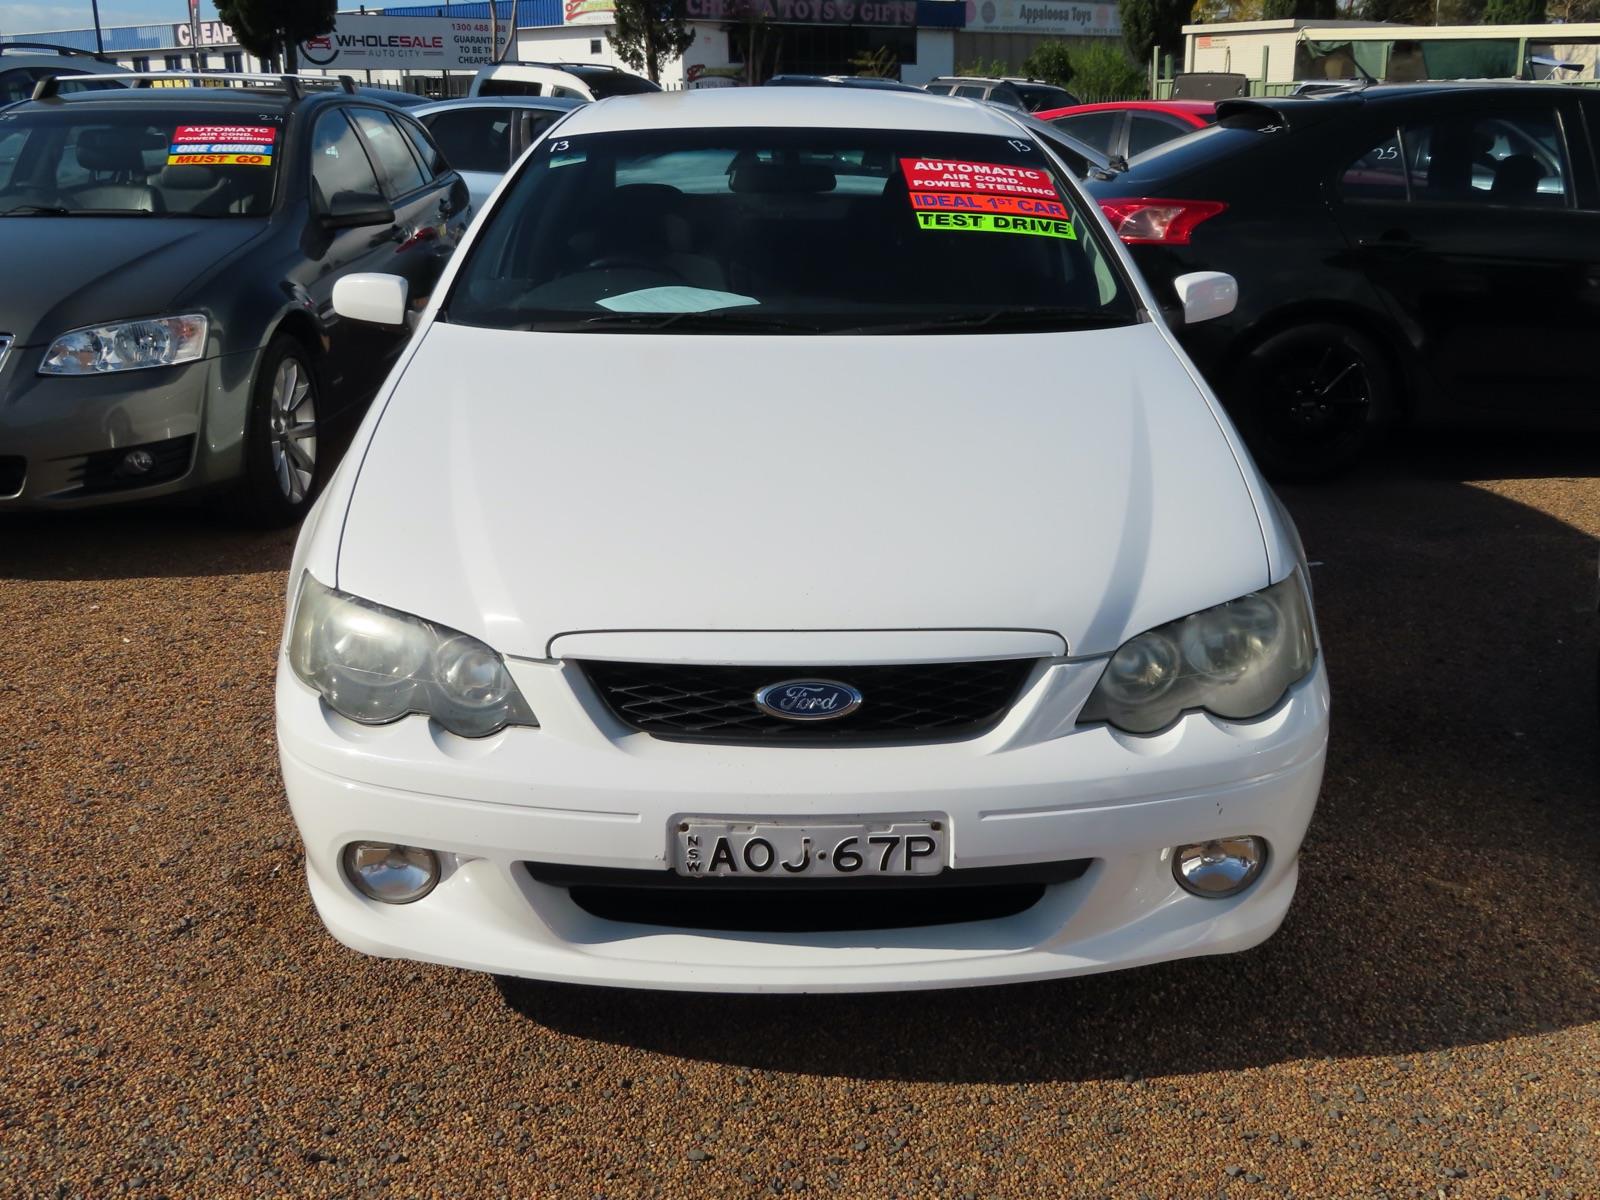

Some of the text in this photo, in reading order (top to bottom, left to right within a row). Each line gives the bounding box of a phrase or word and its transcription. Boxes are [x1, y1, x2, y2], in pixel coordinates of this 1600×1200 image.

[685, 0, 917, 21] CHEA TOYS & GIFTS
[1019, 4, 1092, 25] Appaloosa Toys
[178, 22, 238, 46] CEAP
[452, 23, 471, 32] 1300
[336, 34, 443, 48] WHOLESALE
[454, 35, 505, 45] GUARANTED
[368, 49, 395, 57] AUTO
[473, 46, 482, 54] BE
[458, 56, 497, 64] CHEAPES
[176, 144, 265, 153] ONE OWNER
[550, 140, 569, 153] 13
[1007, 139, 1031, 152] 13
[176, 155, 263, 164] MUST GO
[1373, 146, 1398, 160] 25
[914, 161, 1040, 180] AUTOMATIC
[942, 173, 1023, 185] AIR COND.
[913, 180, 1055, 196] POWER STEERING
[914, 195, 982, 209] IDEAL
[1018, 200, 1064, 215] CAR
[919, 213, 1070, 235] TEST DRIVE
[780, 686, 839, 710] Ford
[687, 836, 700, 872] NSW
